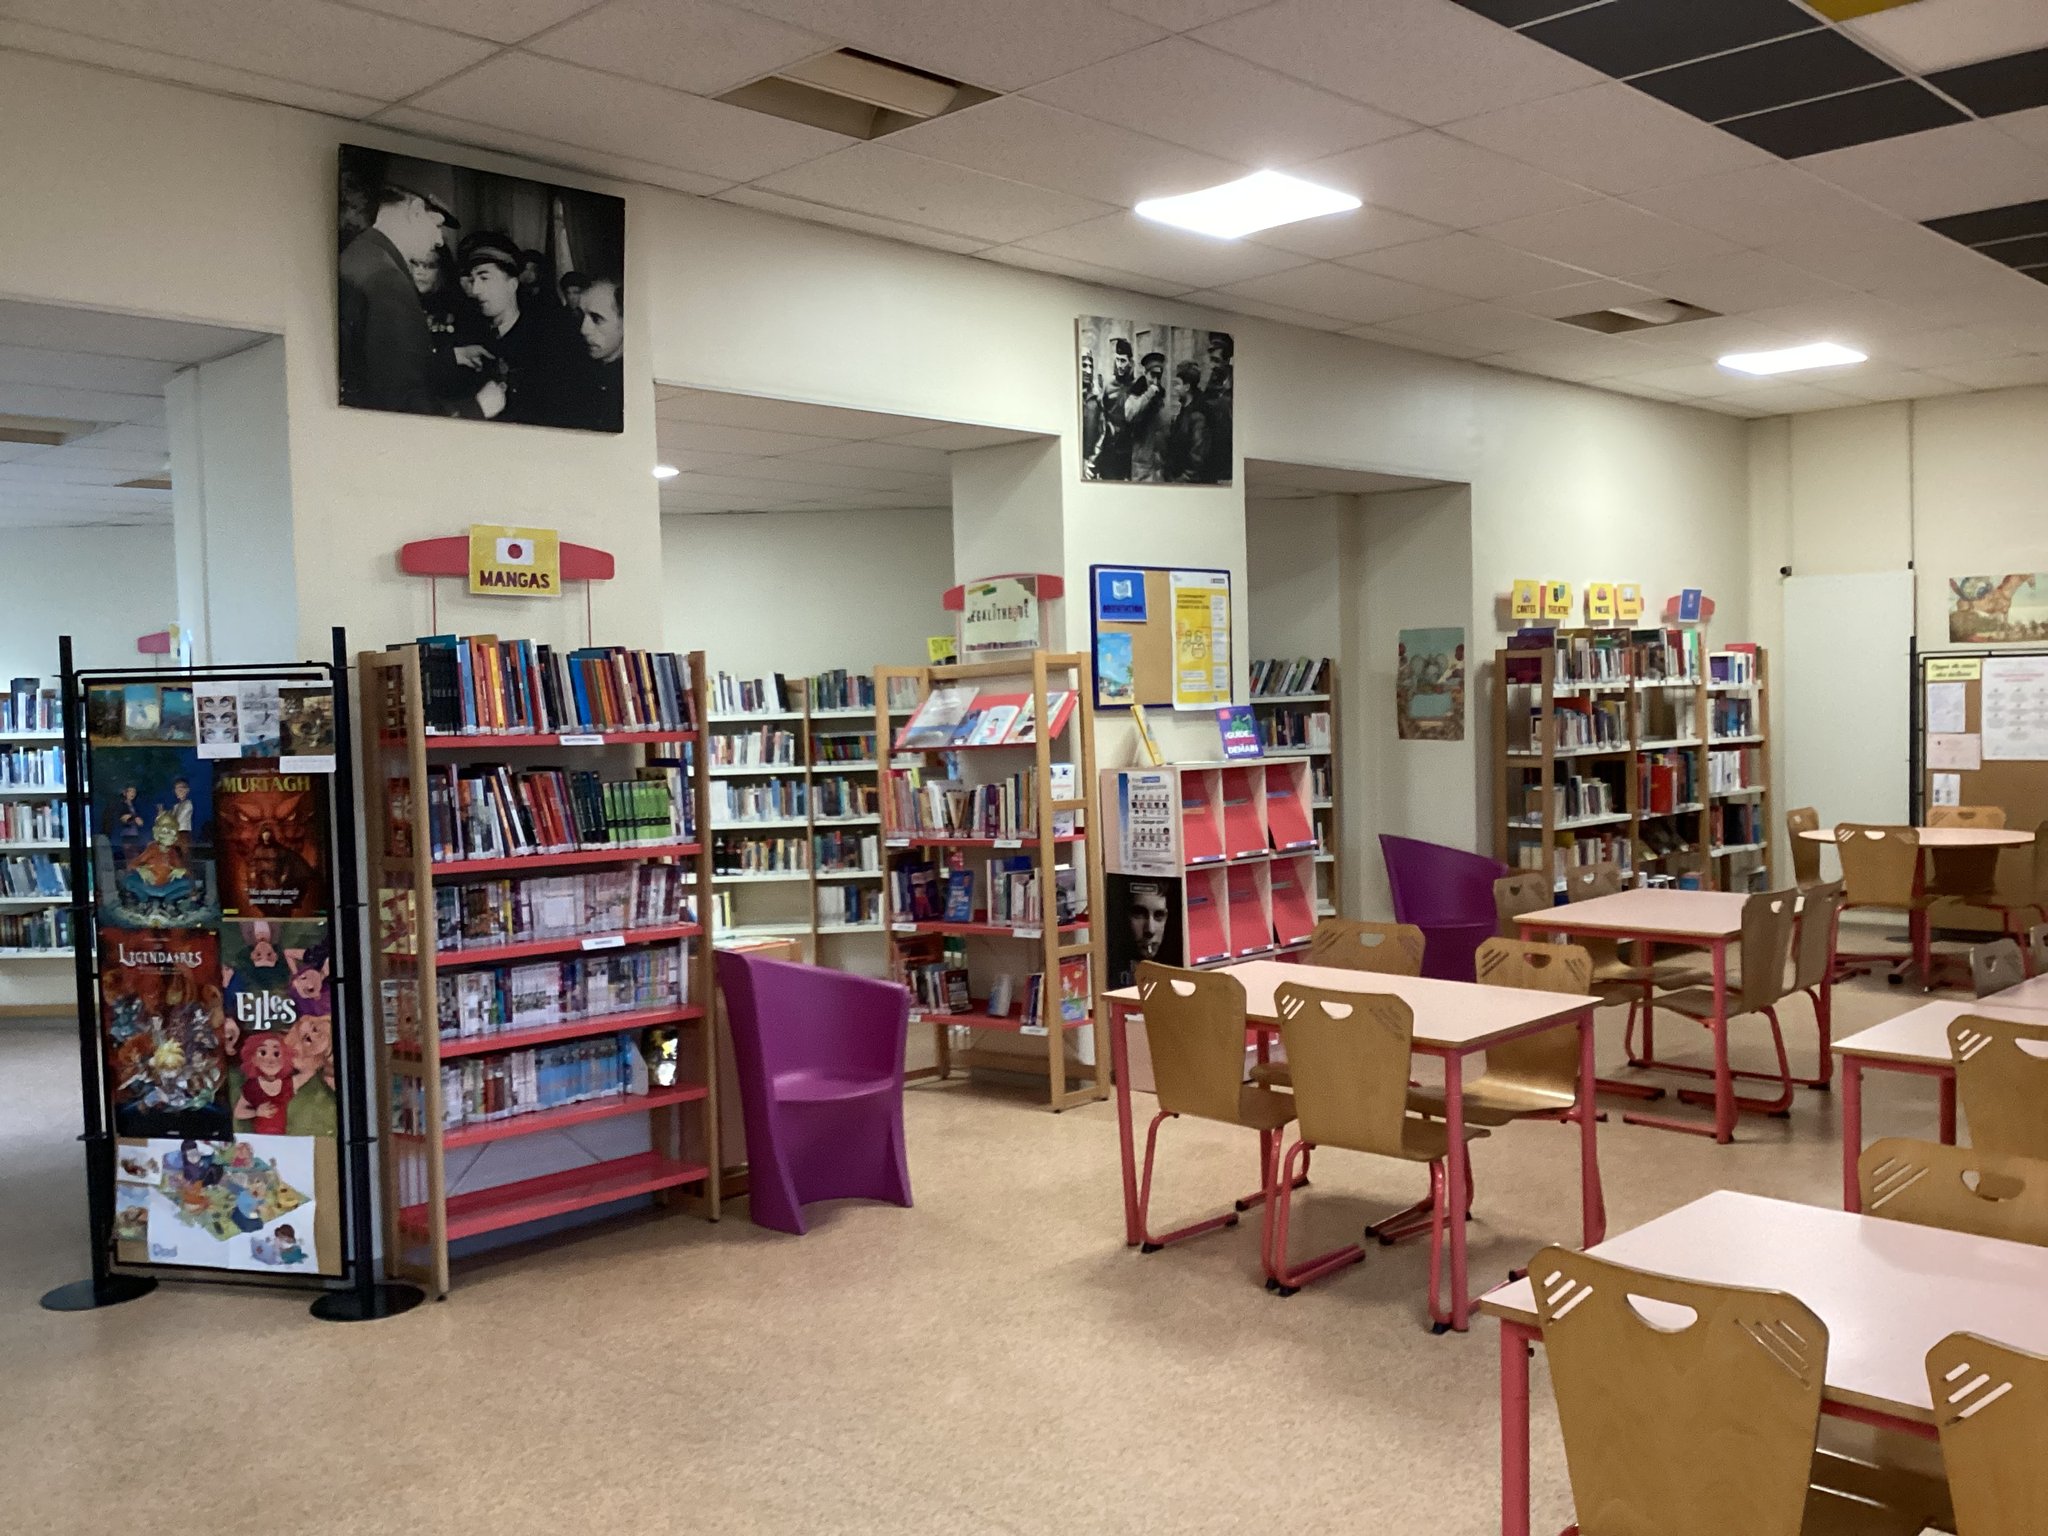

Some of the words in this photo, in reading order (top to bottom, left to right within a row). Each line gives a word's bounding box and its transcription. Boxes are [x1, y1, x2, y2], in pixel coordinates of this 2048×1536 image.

[480, 569, 550, 589] MANGAS
[222, 776, 310, 793] MURTAGH
[235, 990, 297, 1031] Elles
